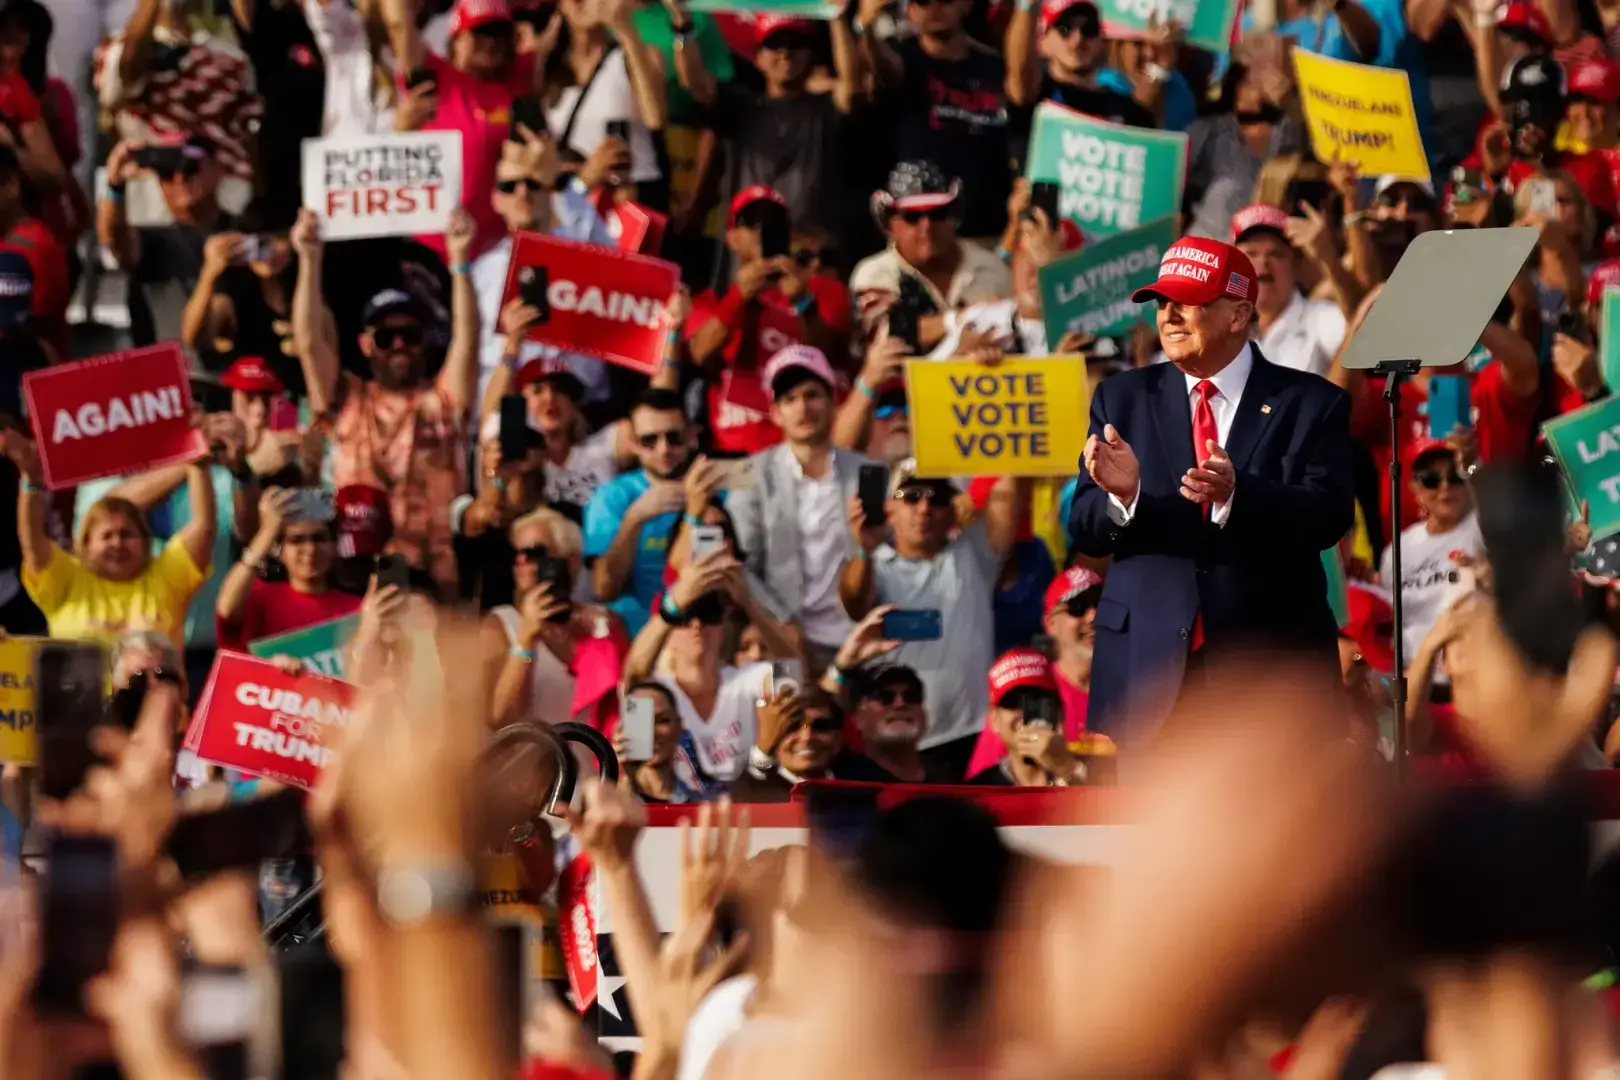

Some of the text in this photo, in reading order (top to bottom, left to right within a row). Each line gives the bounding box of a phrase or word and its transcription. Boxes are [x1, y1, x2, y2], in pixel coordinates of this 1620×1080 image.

[325, 144, 443, 166] PUTTING
[1062, 129, 1147, 171] VOTE
[325, 166, 443, 186] FLORIDA
[1059, 157, 1144, 200] VOTE
[326, 184, 443, 217] FIRST
[1057, 190, 1141, 227] VOTE
[1175, 246, 1219, 268] AMERICA
[1056, 244, 1158, 303] LATINOS
[1176, 262, 1211, 284] AGAIN
[547, 279, 664, 329] GAIN!
[949, 373, 1046, 397] VOTE
[52, 385, 184, 444] AGAIN!
[952, 402, 1048, 427] VOTE
[954, 432, 1050, 459] VOTE
[271, 711, 322, 742] FOR
